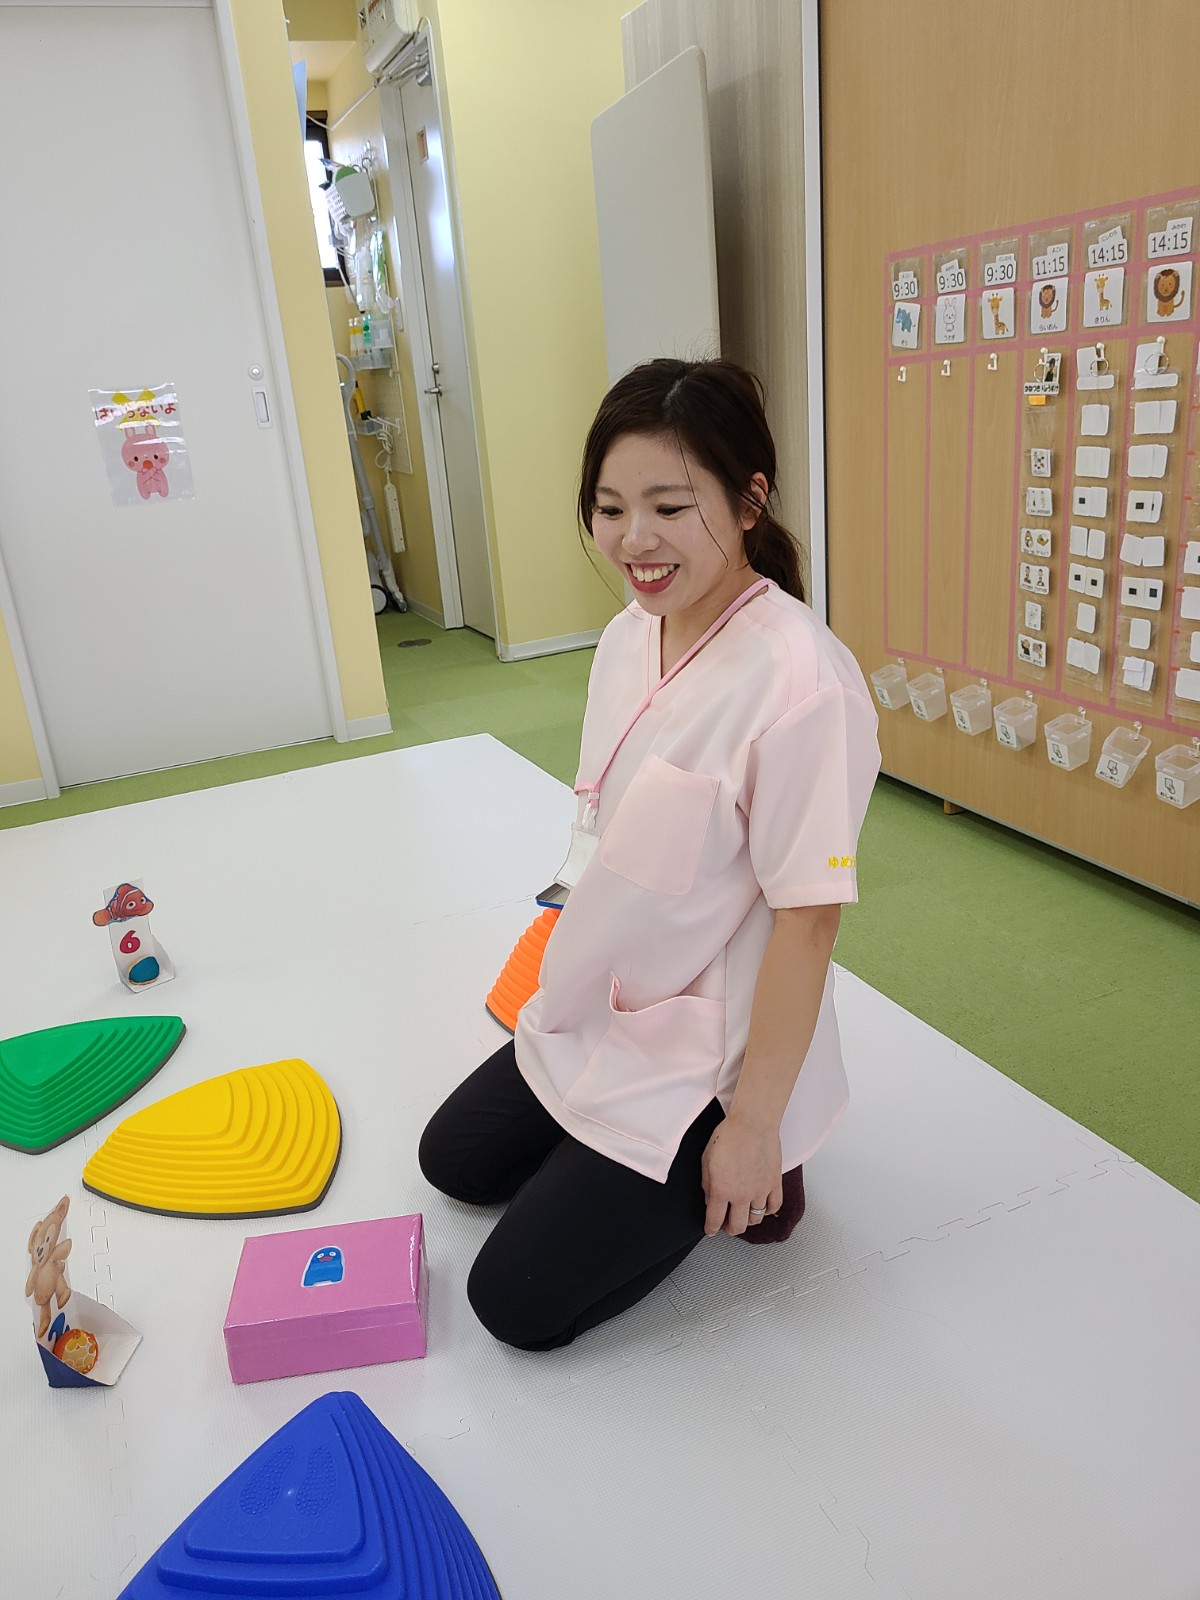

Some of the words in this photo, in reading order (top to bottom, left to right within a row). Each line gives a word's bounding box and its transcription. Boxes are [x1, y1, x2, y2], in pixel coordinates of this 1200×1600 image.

[1151, 231, 1189, 254] 14:15
[1091, 243, 1125, 265] 14:15
[986, 263, 1014, 282] 9:30
[1035, 256, 1065, 276] 11:15
[893, 280, 916, 298] 9:30
[938, 271, 964, 291] 9:30
[1094, 315, 1111, 324] きりん
[119, 930, 141, 954] 6
